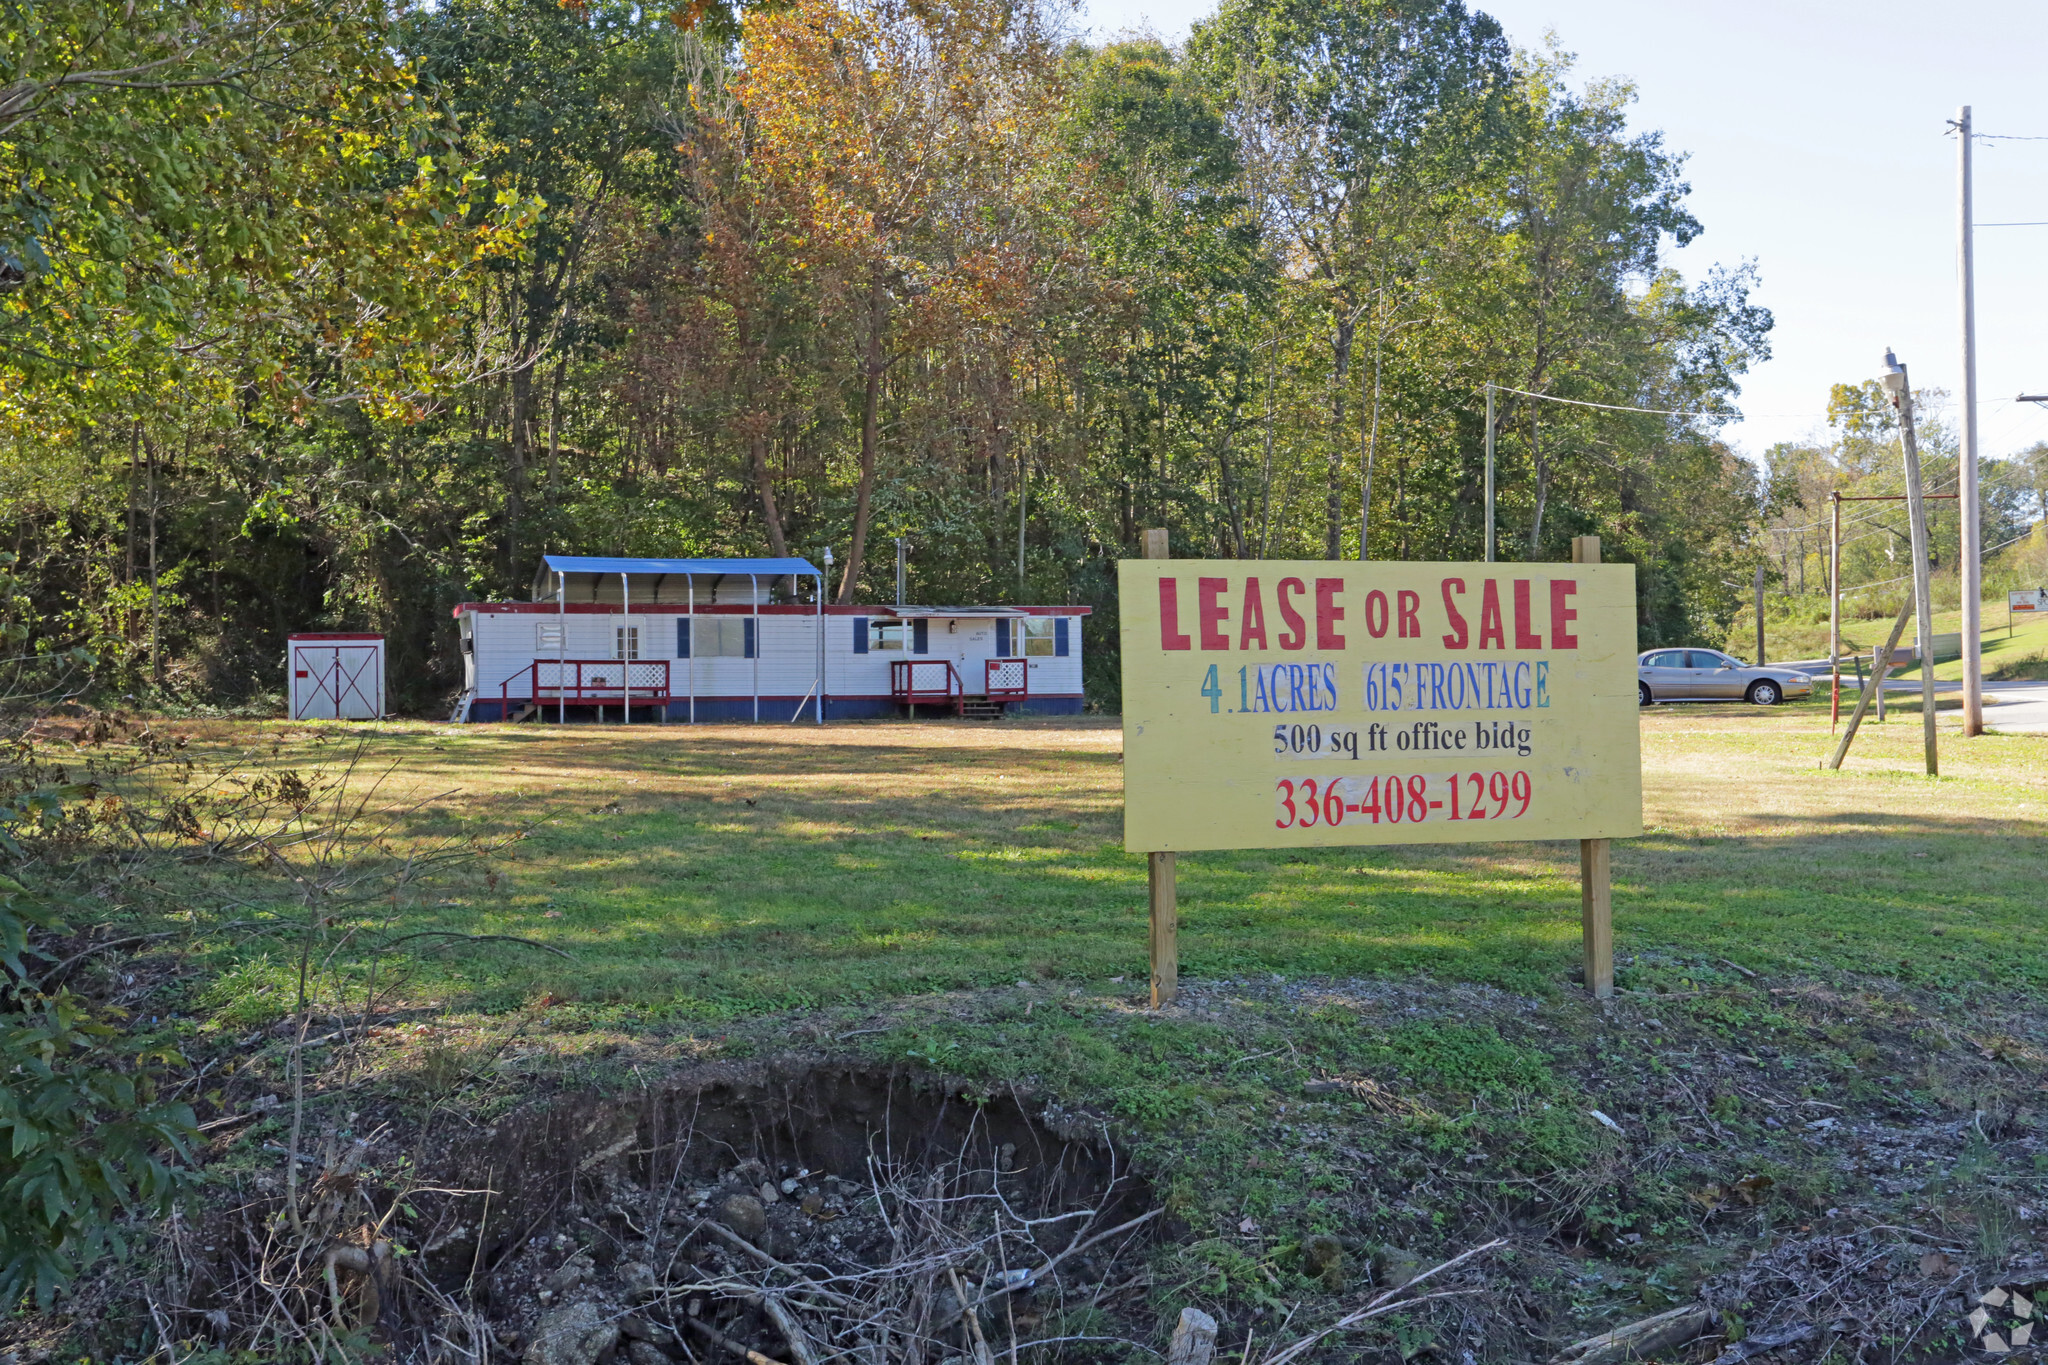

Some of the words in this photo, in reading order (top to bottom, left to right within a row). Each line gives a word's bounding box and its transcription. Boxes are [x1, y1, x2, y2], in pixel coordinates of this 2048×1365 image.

[1158, 577, 1345, 651] LEASE
[1365, 589, 1421, 639] OR
[1441, 577, 1578, 650] SALE
[1274, 724, 1322, 754] 500
[1330, 731, 1360, 761] sq
[1367, 722, 1388, 752] ft
[1396, 721, 1467, 751] office
[1275, 770, 1532, 830] 336-408-1299
